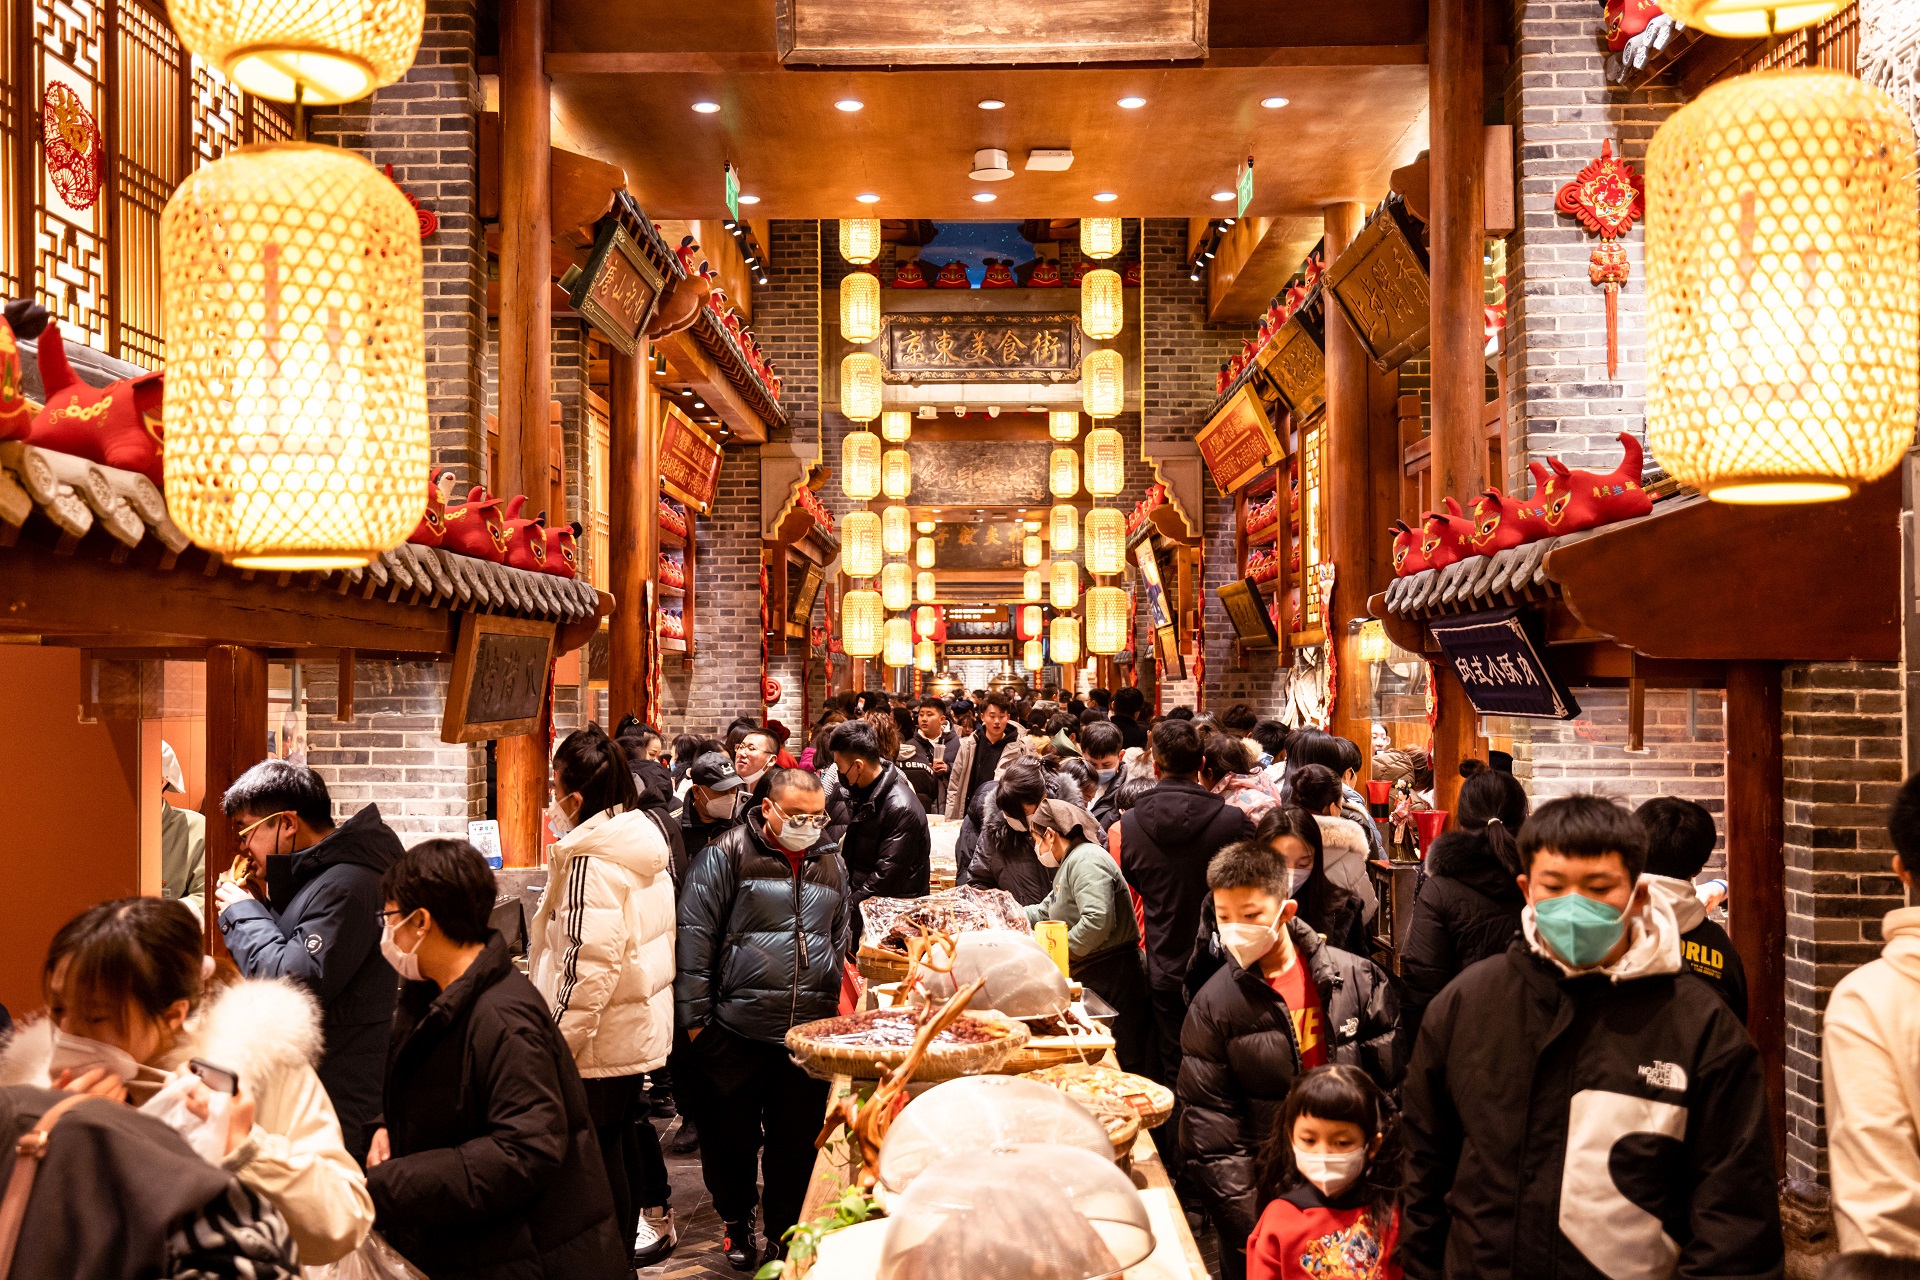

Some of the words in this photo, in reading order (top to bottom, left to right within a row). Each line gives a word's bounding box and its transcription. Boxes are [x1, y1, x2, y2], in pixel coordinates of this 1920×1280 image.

[899, 328, 1062, 366] 京東美食街
[1454, 651, 1540, 687] 邱式小酥肉
[1638, 1065, 1672, 1079] NORTH
[1653, 1060, 1672, 1070] THE
[1646, 1075, 1671, 1086] FACE
